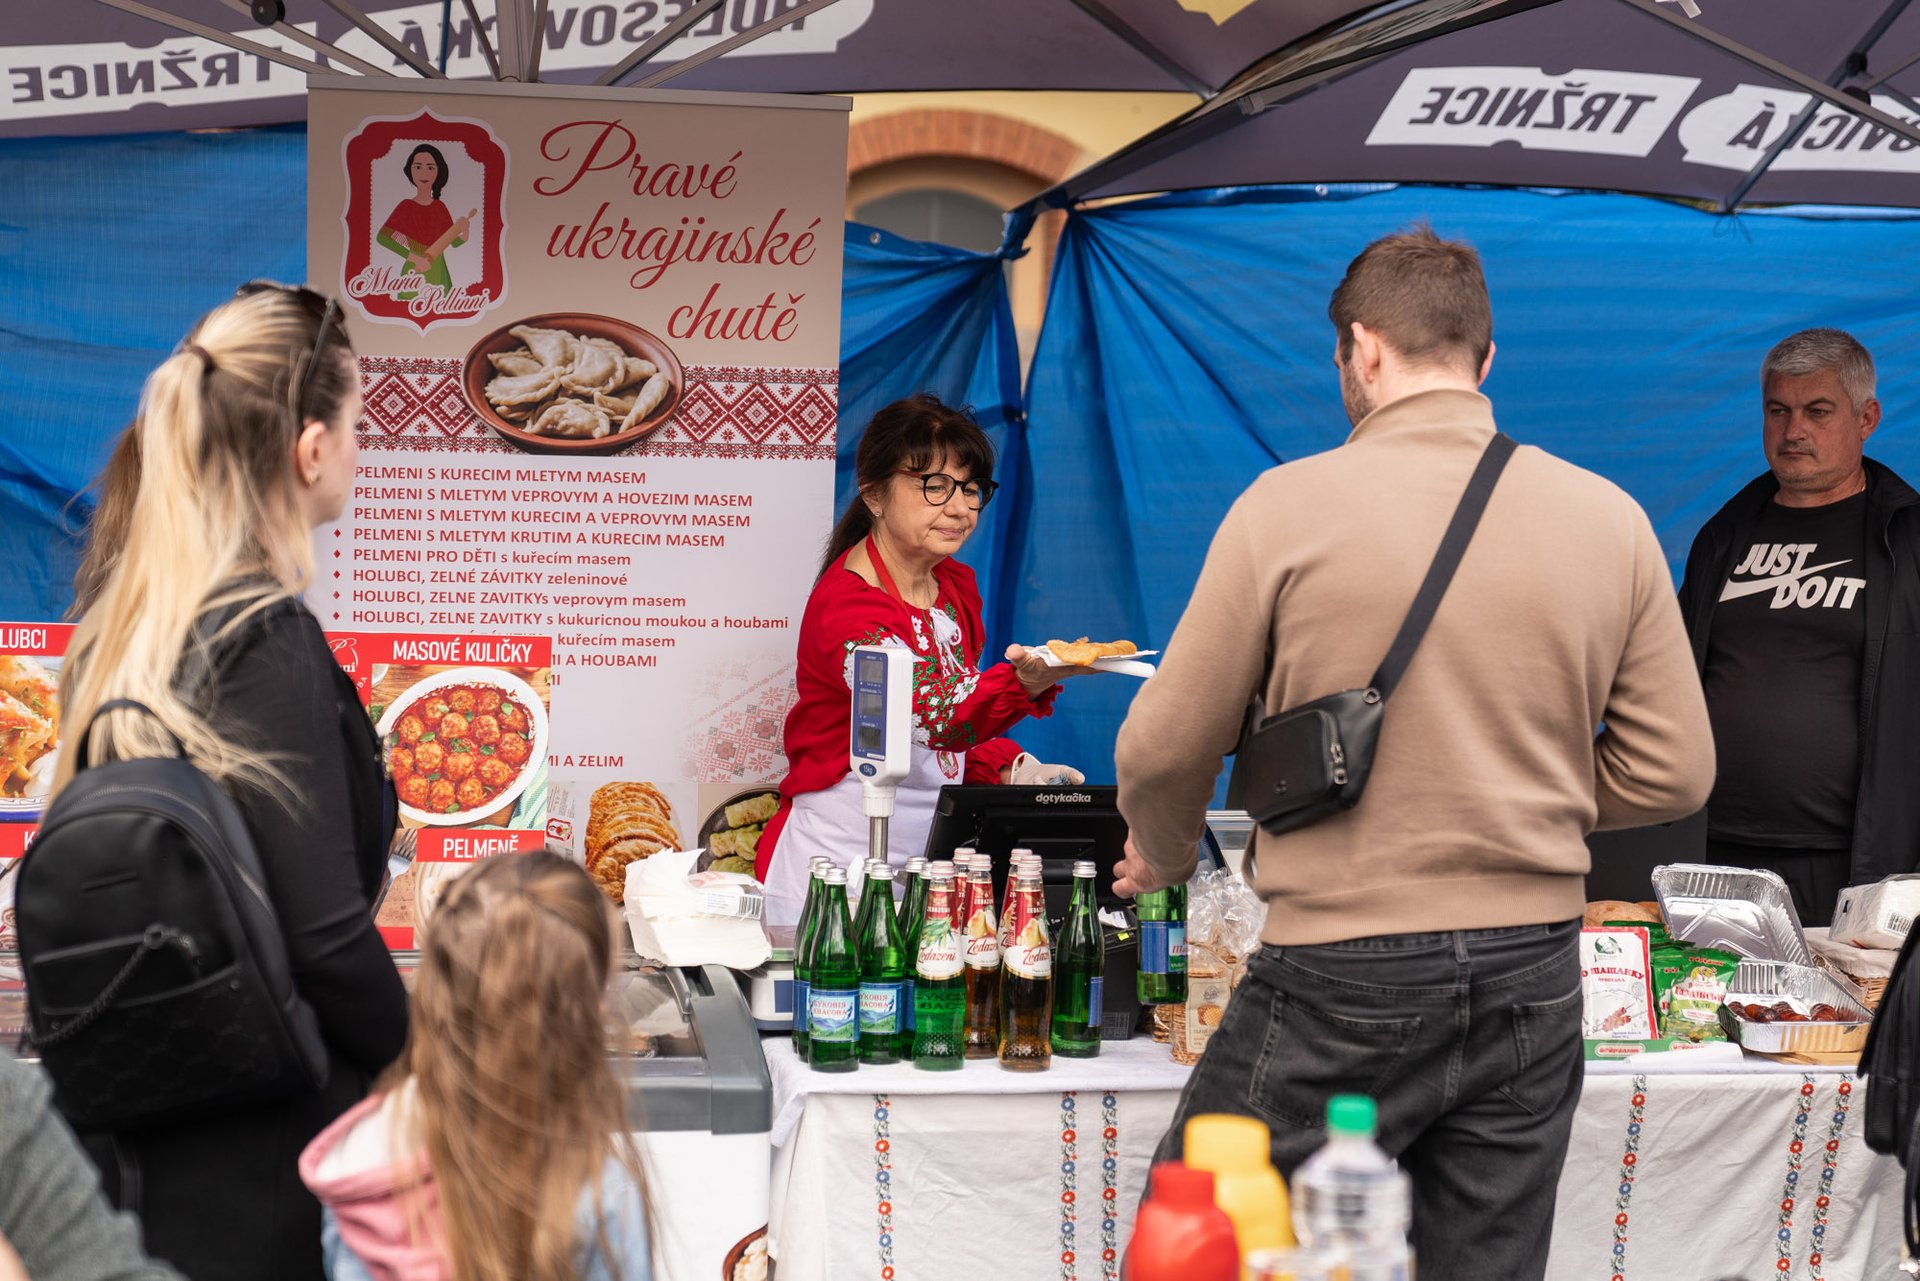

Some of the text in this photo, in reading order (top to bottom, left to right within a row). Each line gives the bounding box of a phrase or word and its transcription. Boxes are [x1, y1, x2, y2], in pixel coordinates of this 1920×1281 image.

[533, 118, 744, 199] Pravé
[546, 202, 822, 290] ukrajinské
[350, 265, 422, 296] Maria
[667, 283, 806, 342] chutě
[354, 465, 646, 484] PELMENI S KURECIM MLETYM MASEM
[354, 486, 752, 508] PELMENI S MLETYM VEPROVYM A HOVEZIM MASEM
[355, 507, 750, 527] PELMENI S MLETYM KURECIM A VEPROVYM MASEM
[354, 528, 724, 546] PELMENI S MLETYM KRUTIM A KURECIM MASEM
[353, 548, 631, 565] PELMENI PRO DĚTI s kuřecím masem
[1733, 543, 1818, 576] JUST
[353, 569, 627, 586] HOLUBCI, ZELNÉ ZÁVITKY zeleninové
[353, 590, 424, 605] HOLUBCI,
[430, 591, 474, 604] ZELNE
[553, 596, 628, 608] veprovym
[632, 597, 686, 607] masem
[353, 611, 788, 629] HOLUBCI, ZELNE ZAVITKY s kukuricnou moukou a houbami
[558, 633, 616, 645] kuřecím
[622, 638, 676, 647] masem
[393, 637, 460, 662] MASOVÉ
[465, 639, 532, 663] KULIČKY
[566, 654, 576, 665] A
[581, 654, 656, 667] HOUBAMI
[564, 755, 574, 766] A
[579, 755, 623, 767] ZELIM
